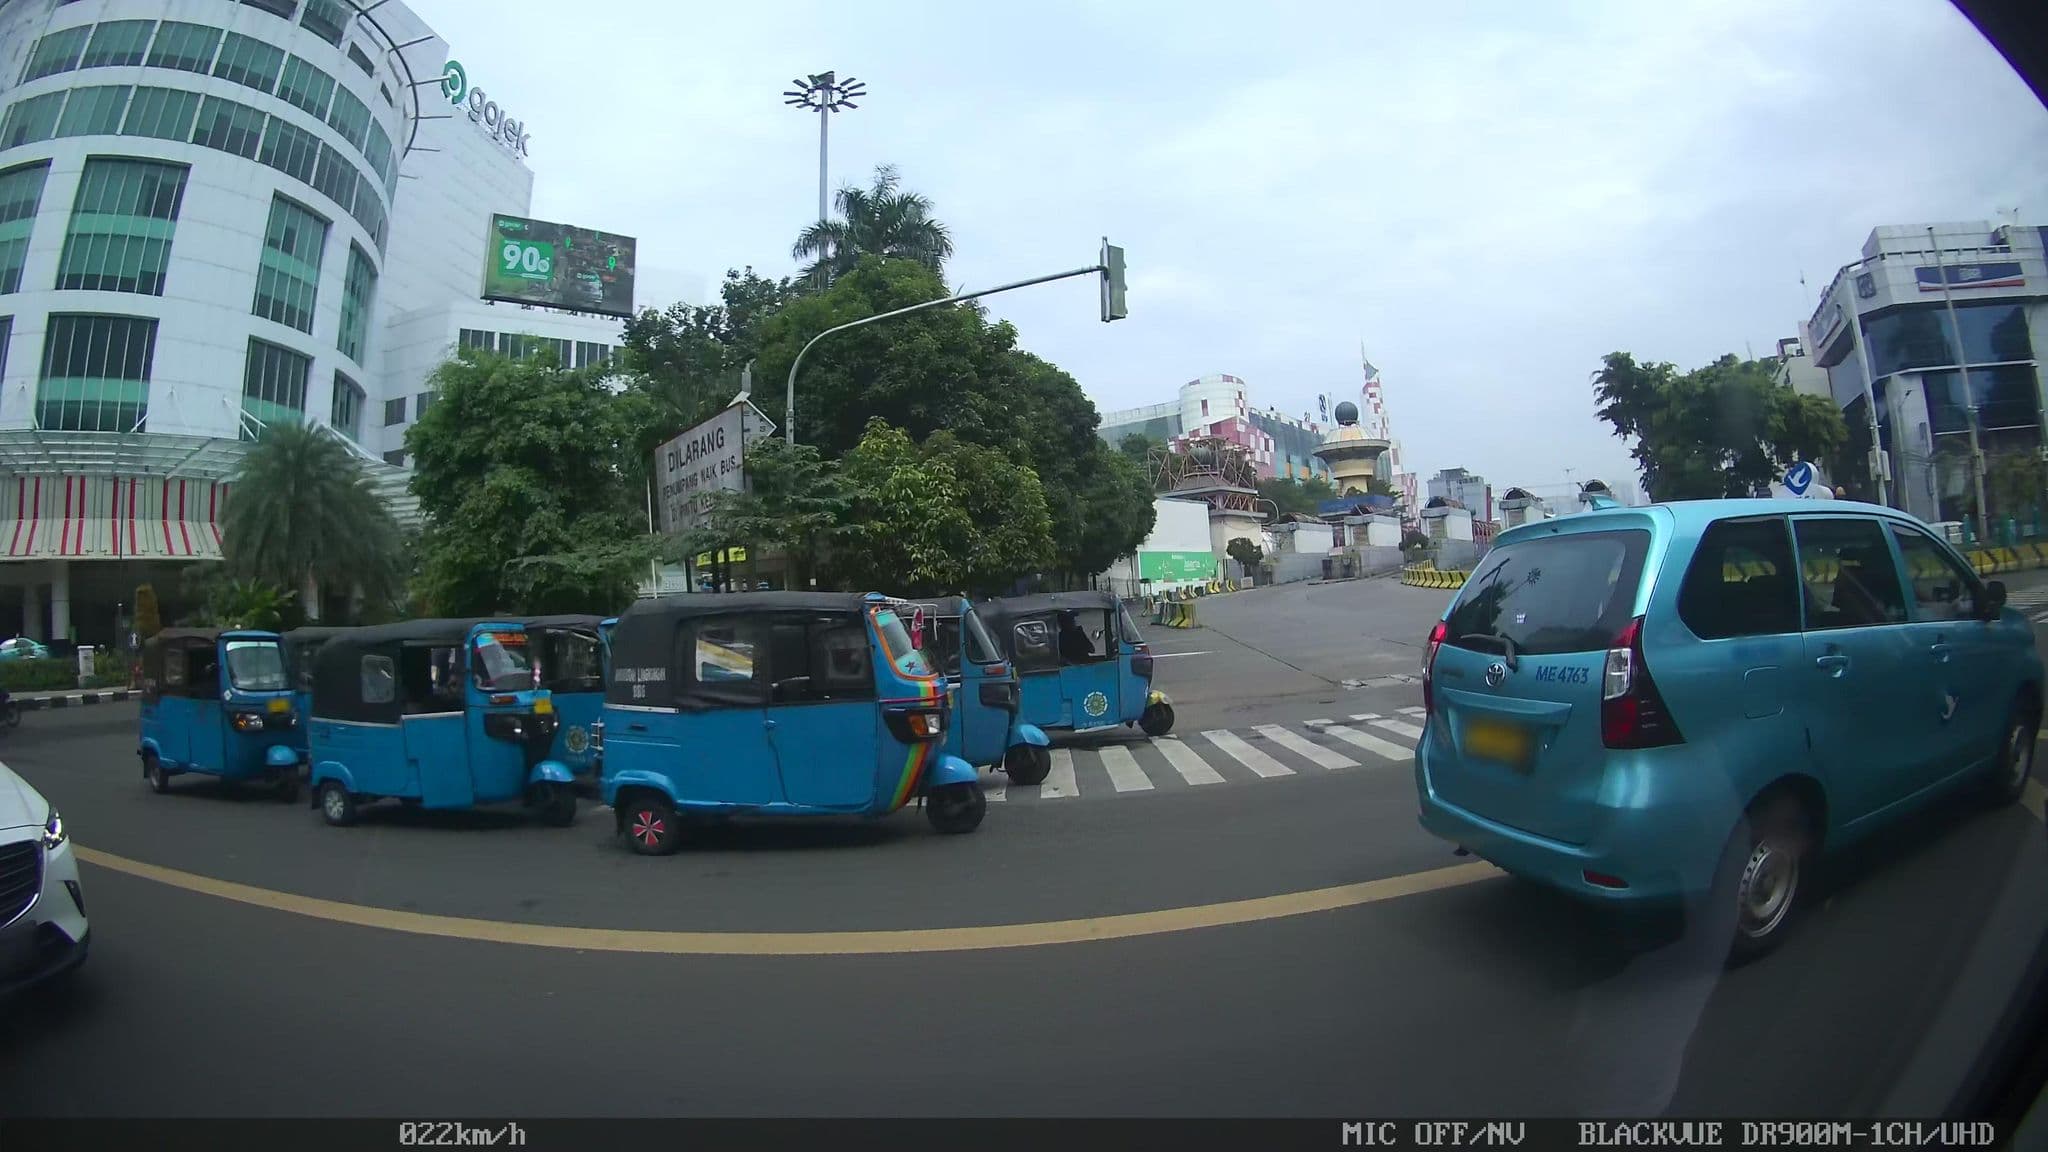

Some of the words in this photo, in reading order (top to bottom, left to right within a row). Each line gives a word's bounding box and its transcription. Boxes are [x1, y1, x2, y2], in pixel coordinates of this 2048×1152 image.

[468, 86, 531, 157] gojek
[668, 427, 725, 472] DILARANG
[701, 463, 718, 482] NAIK
[720, 455, 736, 475] BUS
[1557, 665, 1590, 685] 4763
